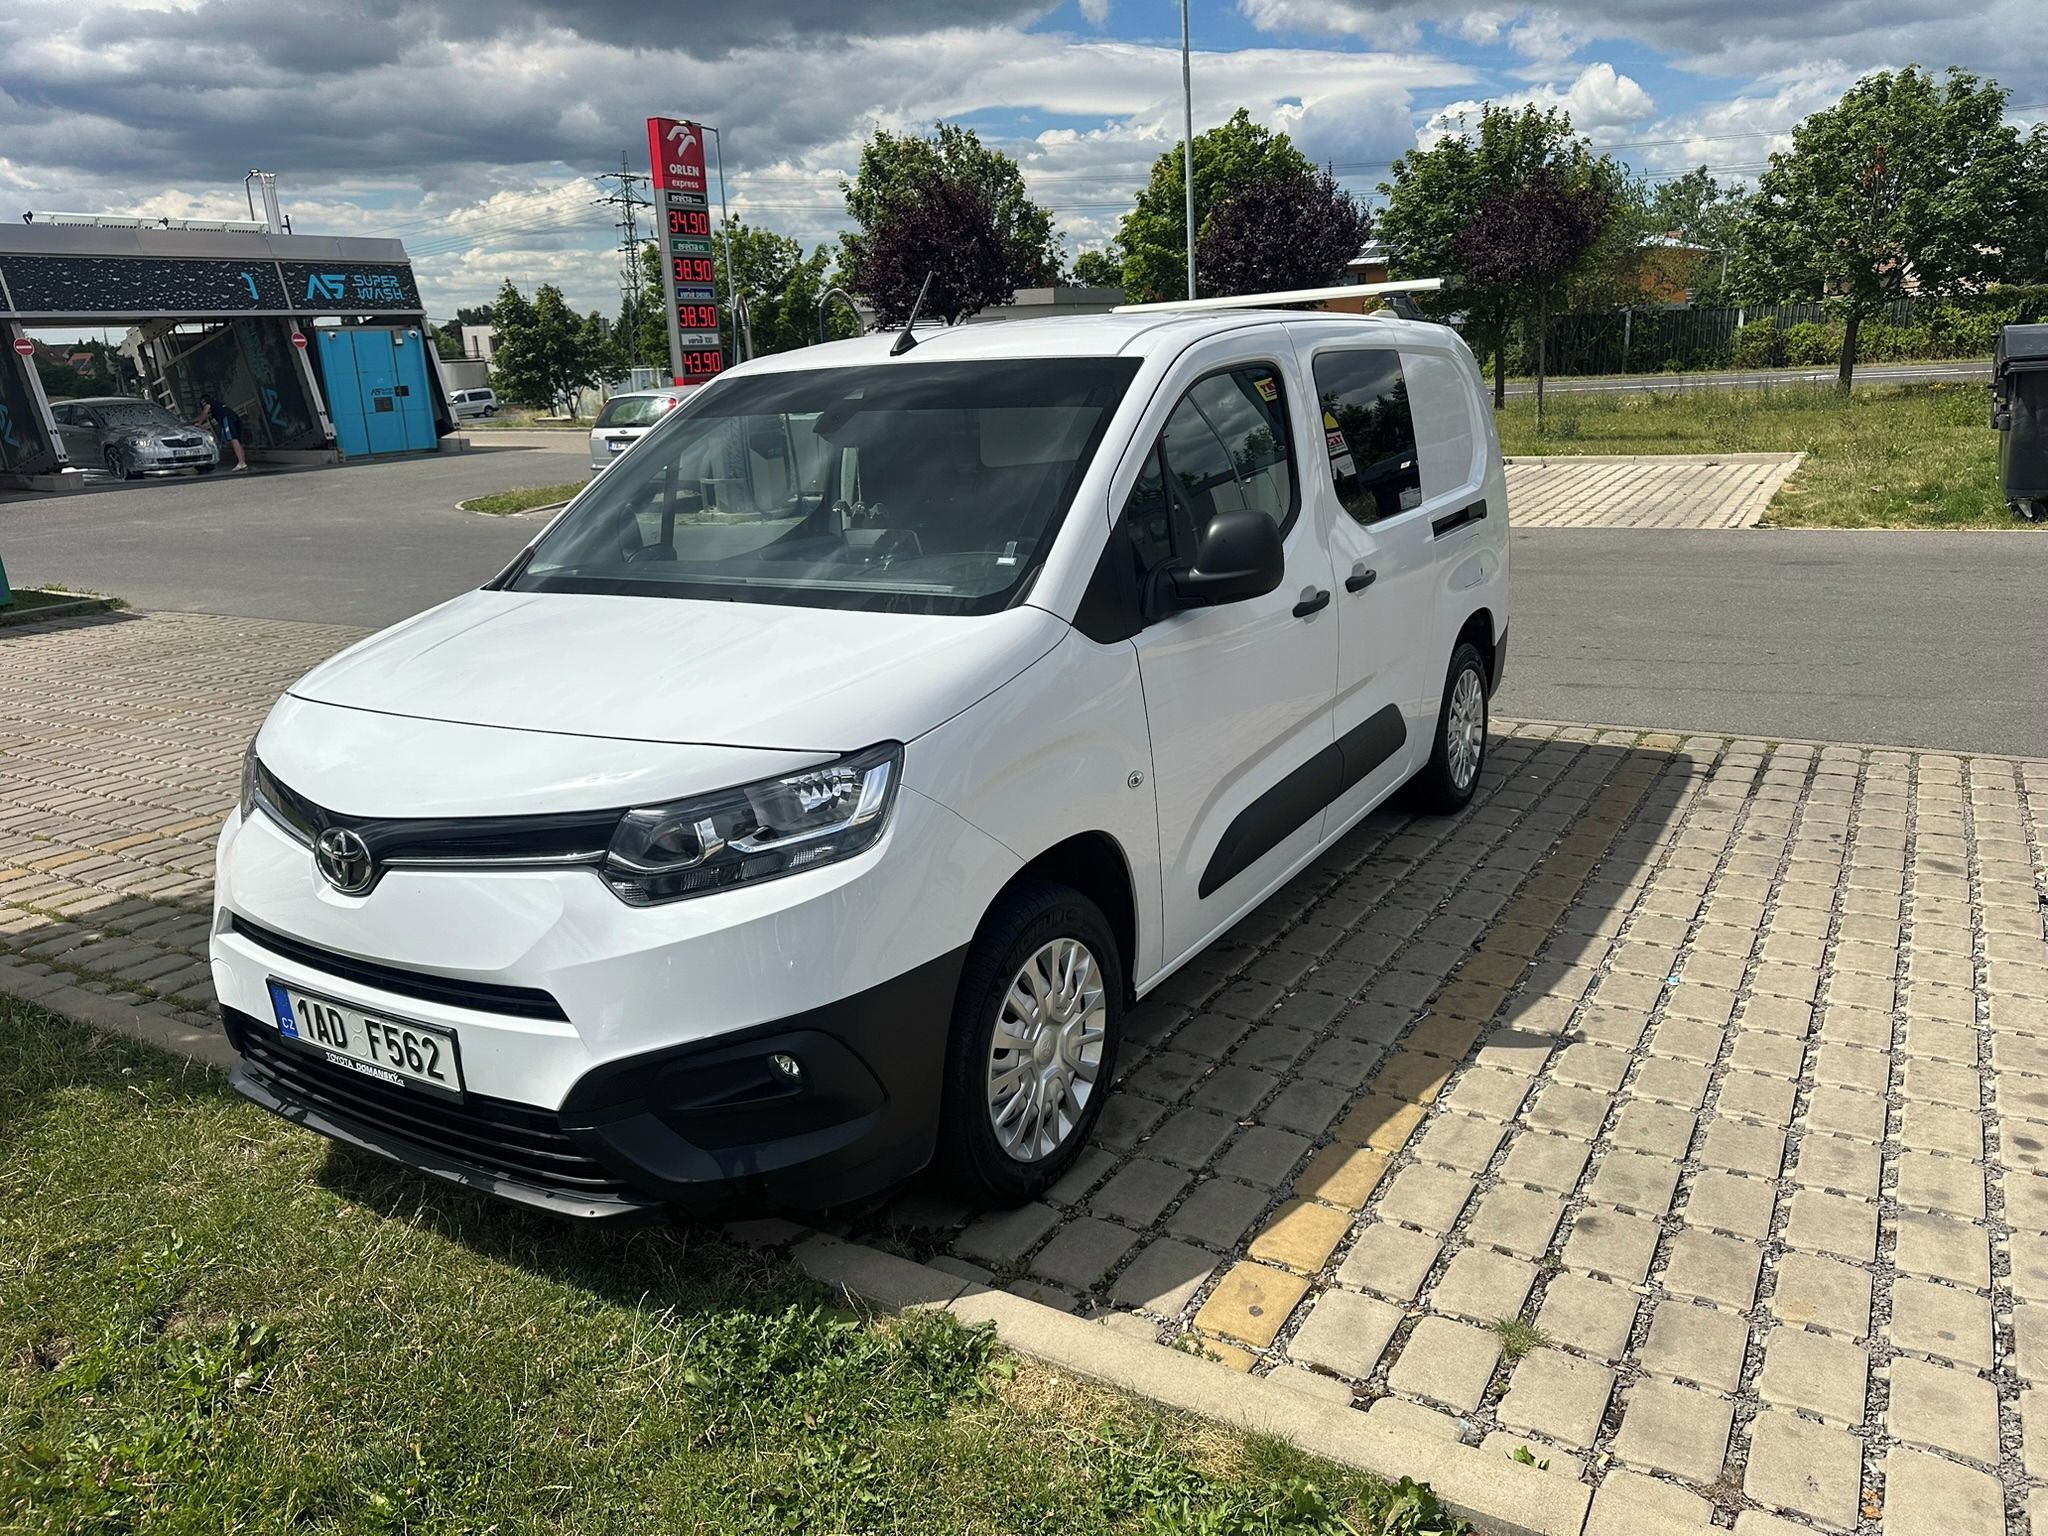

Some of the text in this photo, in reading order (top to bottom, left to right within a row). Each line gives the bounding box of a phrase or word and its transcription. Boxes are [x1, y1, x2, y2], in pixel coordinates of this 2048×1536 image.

[669, 163, 700, 177] ORLEN
[671, 179, 699, 189] express
[669, 210, 708, 234] 34.90
[673, 258, 712, 281] 38.90
[352, 274, 400, 287] SUPER
[356, 287, 405, 300] WASH
[679, 306, 717, 327] 38.90
[683, 352, 721, 373] 43.90
[281, 1016, 296, 1031] CZ
[297, 998, 445, 1081] 1AD F562
[325, 1051, 354, 1069] TOYOTA
